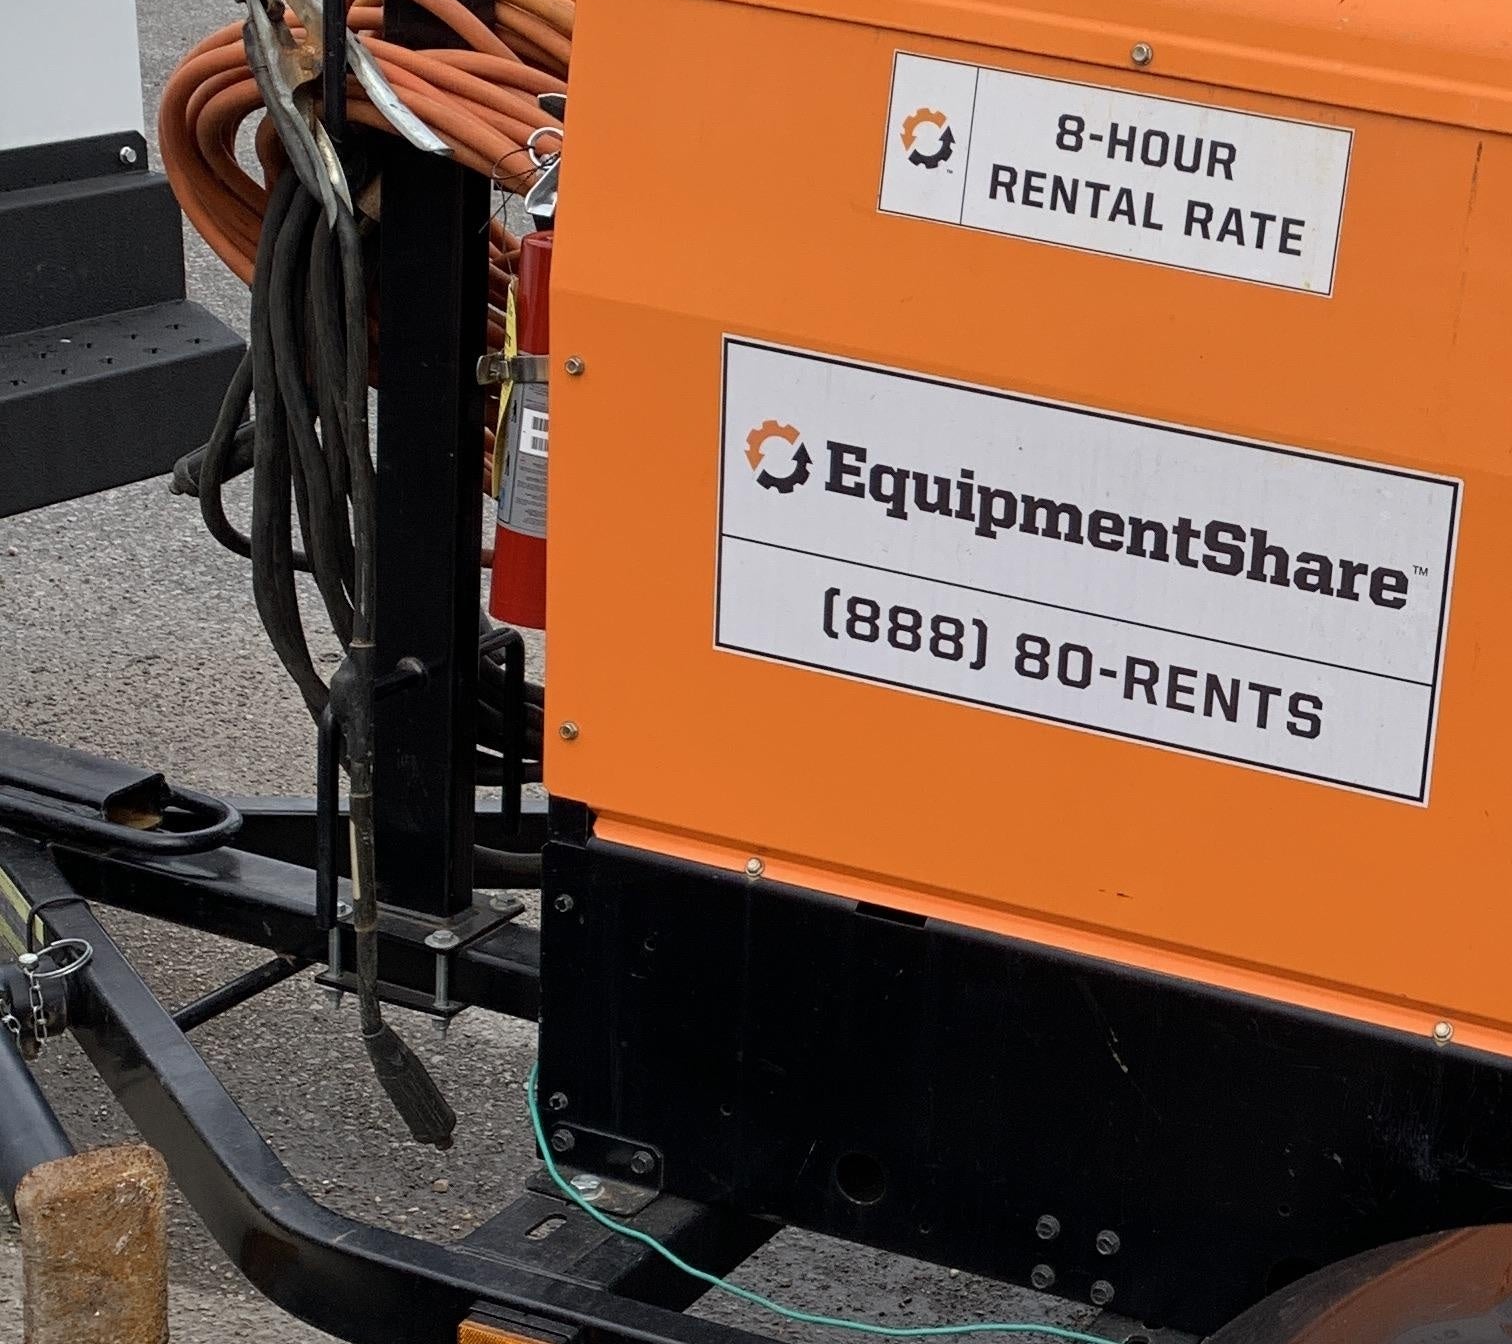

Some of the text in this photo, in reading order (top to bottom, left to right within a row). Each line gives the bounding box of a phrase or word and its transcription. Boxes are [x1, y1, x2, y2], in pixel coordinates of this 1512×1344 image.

[1056, 113, 1237, 181] 8-HOUR
[989, 163, 1306, 256] RENTAL RATE
[824, 439, 1410, 610] EquipmentShare
[822, 586, 1324, 741] (888) 80-RENTS
